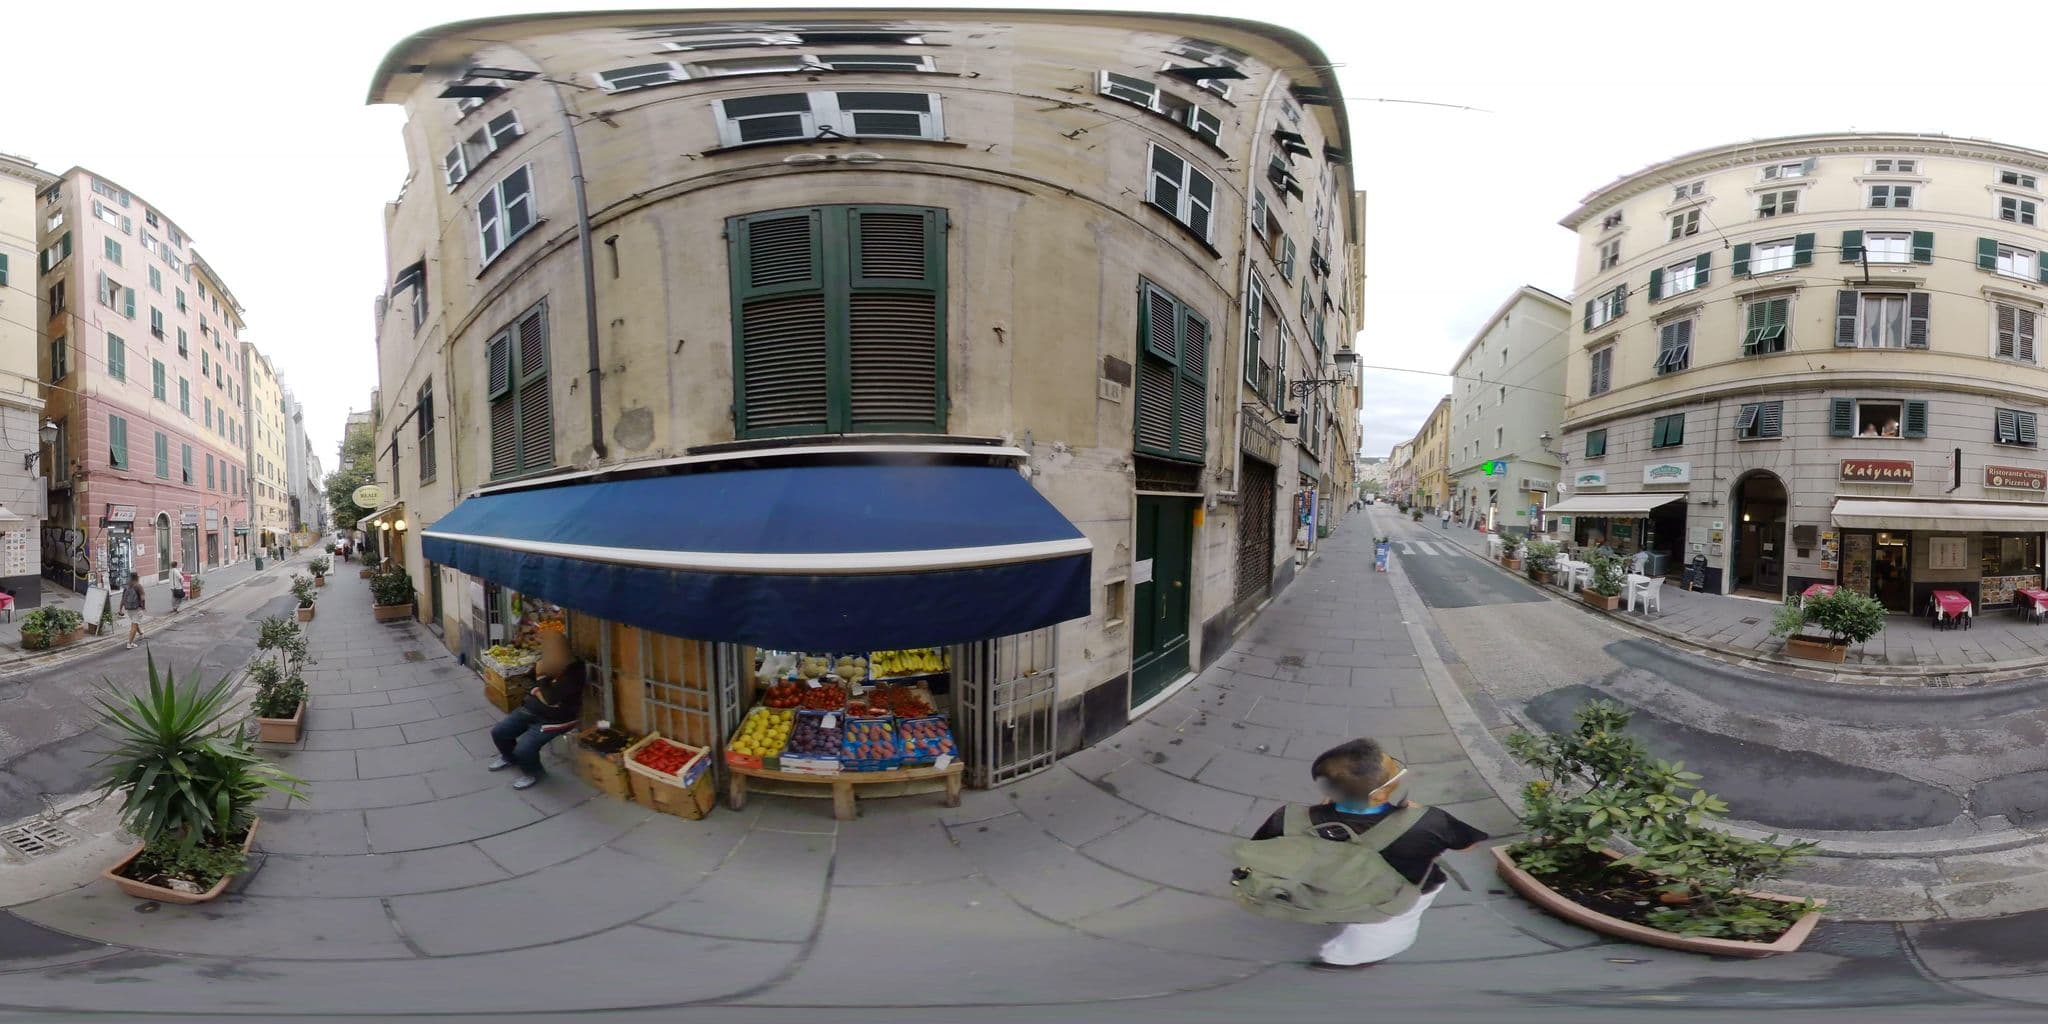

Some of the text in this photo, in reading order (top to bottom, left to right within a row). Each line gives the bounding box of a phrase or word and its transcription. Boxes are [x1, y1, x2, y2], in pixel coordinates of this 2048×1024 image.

[1843, 463, 1912, 481] Kaiyuan
[1988, 468, 2023, 478] Ristorante
[2004, 478, 2030, 487] Pizzeria
